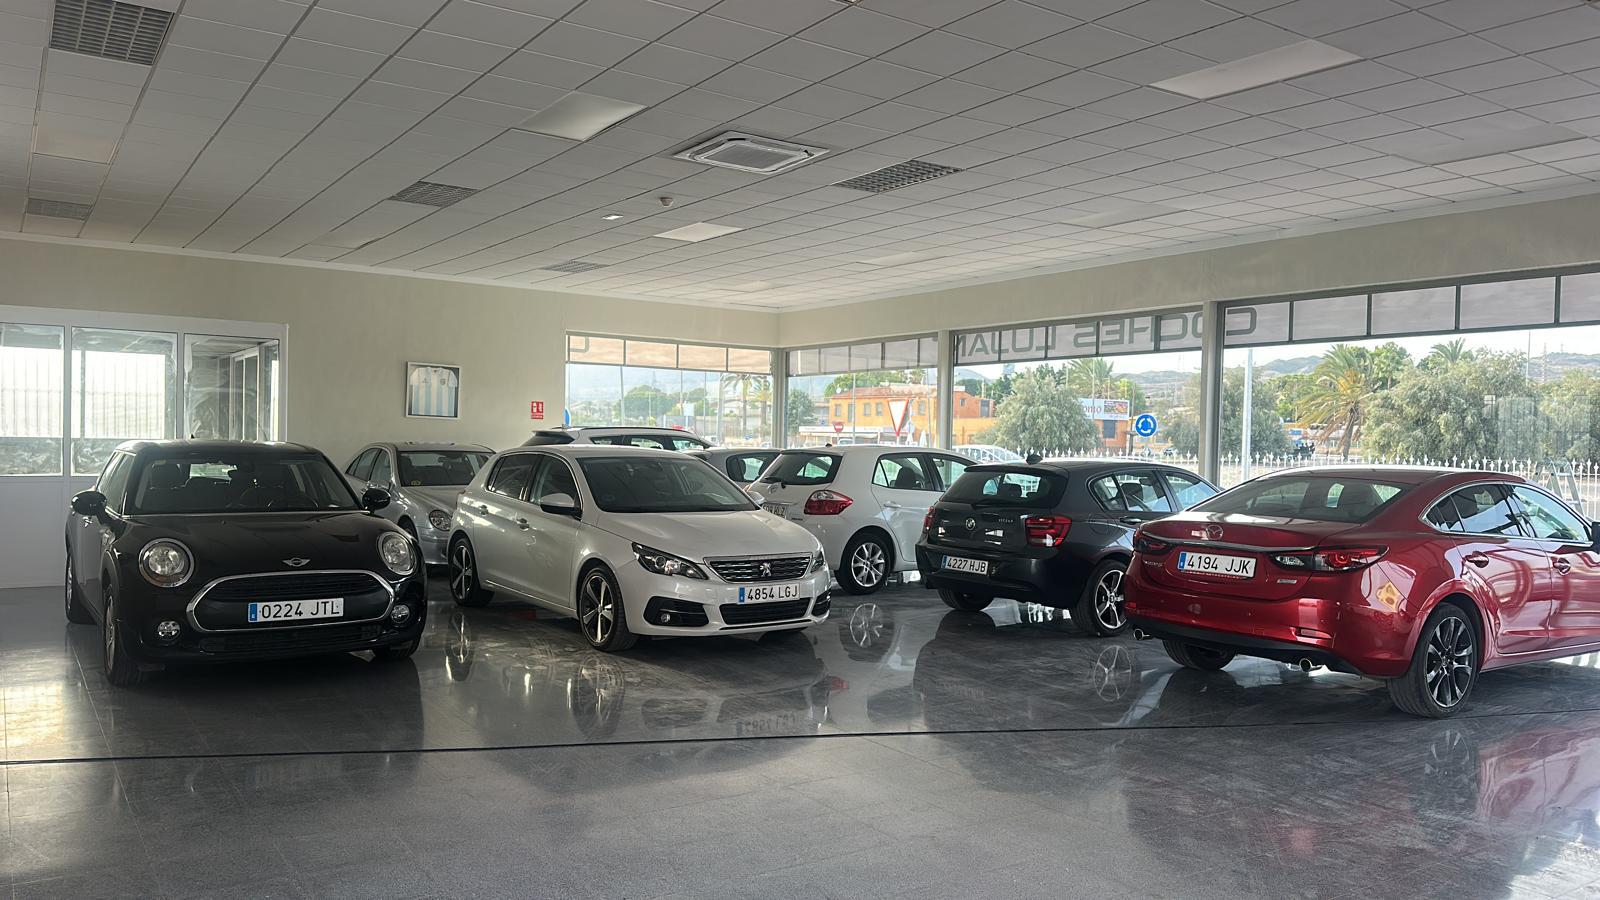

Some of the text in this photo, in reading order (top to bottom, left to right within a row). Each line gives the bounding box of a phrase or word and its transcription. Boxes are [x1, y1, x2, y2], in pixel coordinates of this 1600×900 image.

[947, 557, 986, 573] 4227 HJB
[1187, 555, 1218, 571] 4194
[1225, 558, 1251, 575] JJK
[747, 585, 798, 600] 4854 LGJ
[261, 601, 340, 618] 0224 JTL
